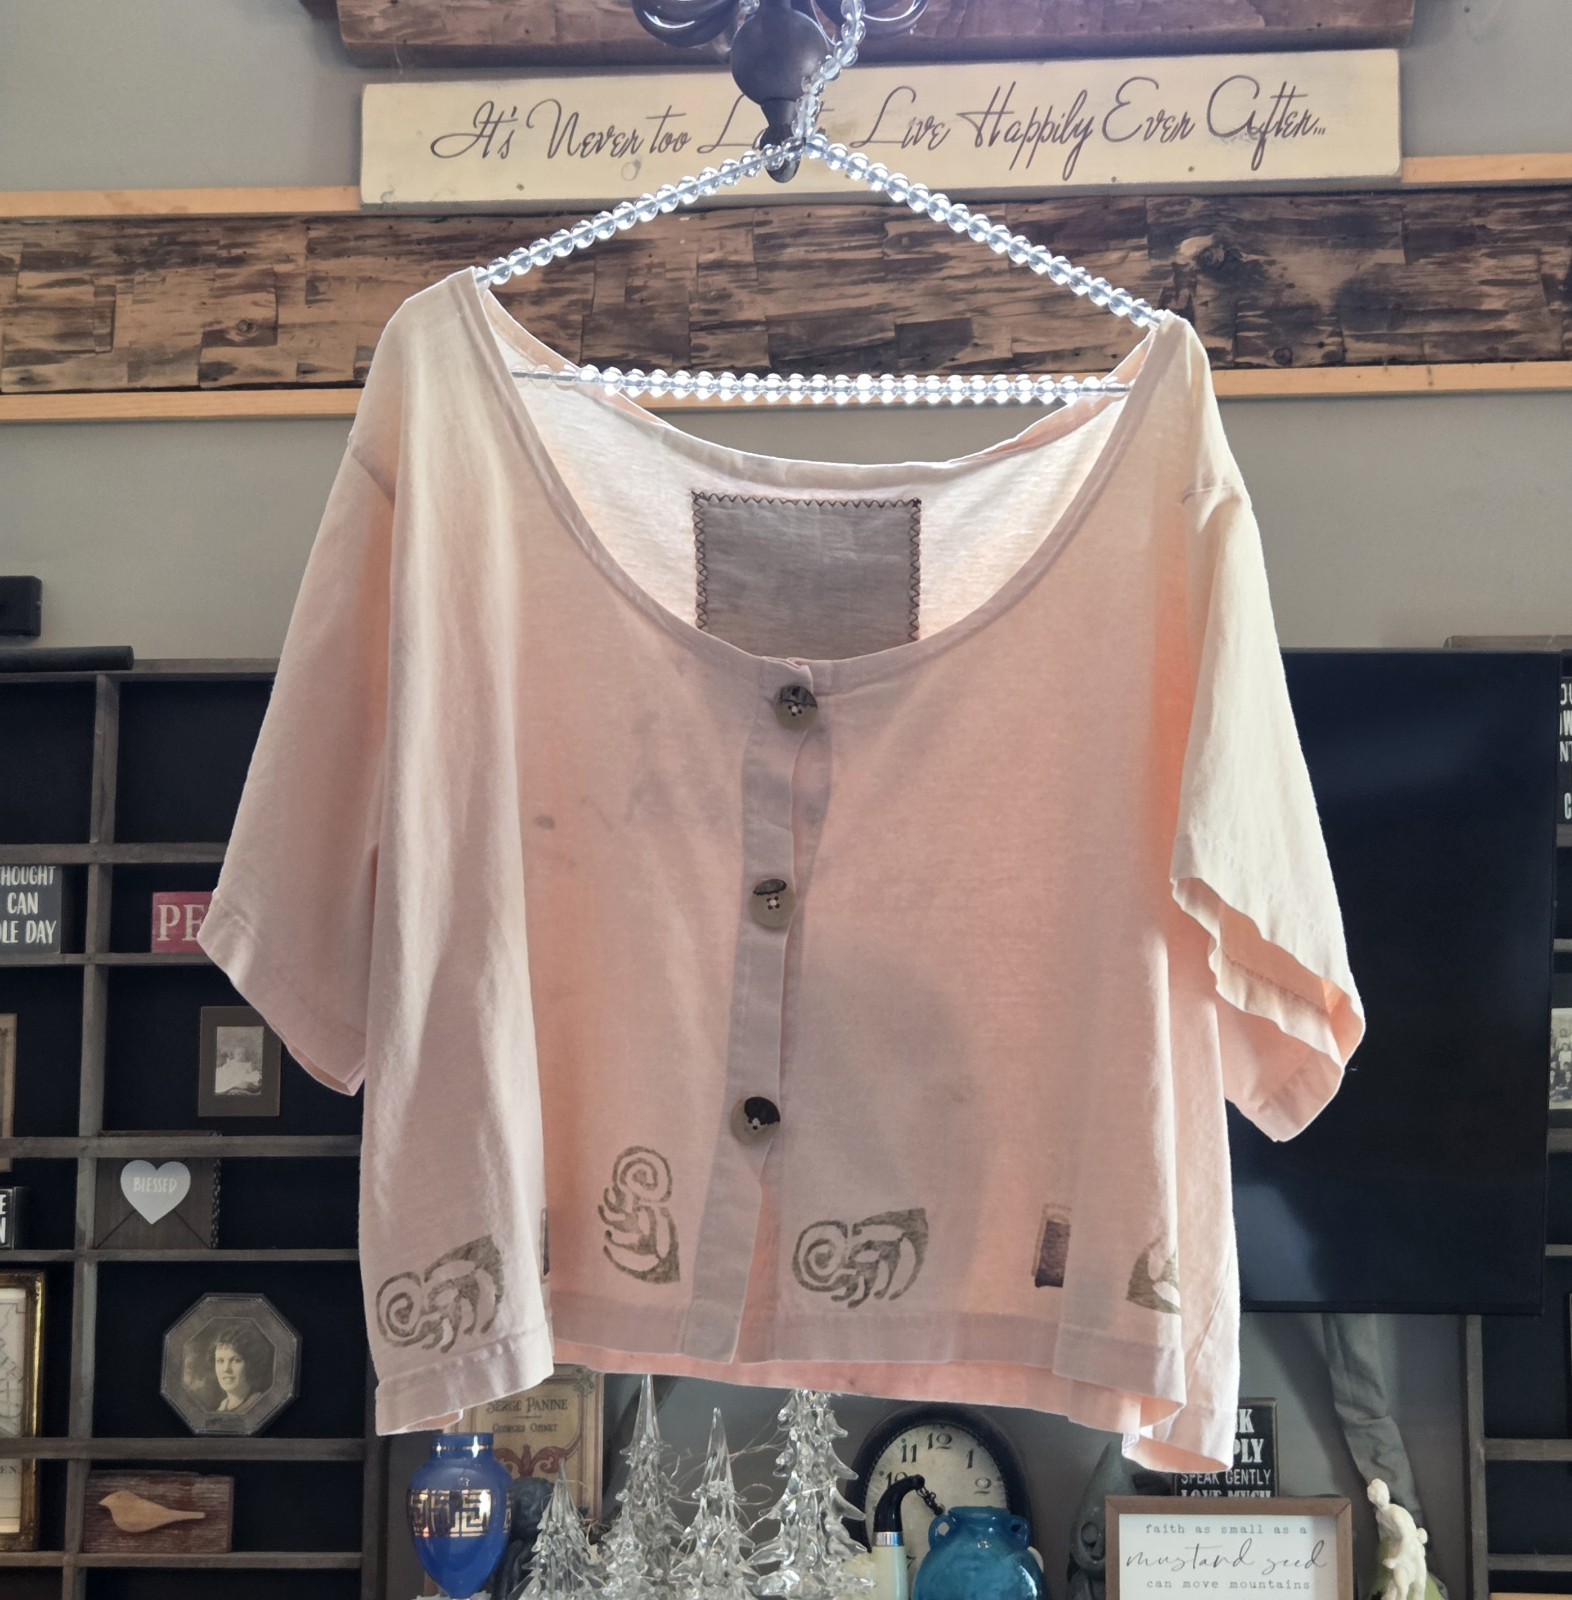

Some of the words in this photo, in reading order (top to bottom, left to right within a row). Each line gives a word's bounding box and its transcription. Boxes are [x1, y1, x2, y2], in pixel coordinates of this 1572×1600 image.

[430, 99, 517, 159] It's
[526, 98, 644, 160] Never
[646, 104, 691, 153] too
[849, 86, 949, 151] Live
[956, 80, 1094, 181] Happily
[1101, 76, 1195, 144] Ever
[0, 866, 56, 887] HOUGHT
[7, 891, 39, 915] CAN
[25, 919, 57, 944] DAY
[133, 1176, 178, 1193] BLESSED
[526, 1396, 569, 1414] PANINE
[927, 1432, 953, 1450] 12
[901, 1443, 918, 1463] 11
[965, 1448, 975, 1470] 1
[974, 1476, 992, 1495] 2
[1225, 1468, 1272, 1485] GENTLY
[1145, 1523, 1185, 1534] faith
[1195, 1526, 1211, 1534] as
[1220, 1524, 1263, 1534] small
[1273, 1526, 1289, 1535] as
[1299, 1526, 1308, 1535] a
[1126, 1537, 1255, 1572] mustard
[1261, 1539, 1328, 1576] seed
[1146, 1581, 1172, 1589] can
[1182, 1580, 1219, 1589] move
[1229, 1579, 1310, 1590] mountains
